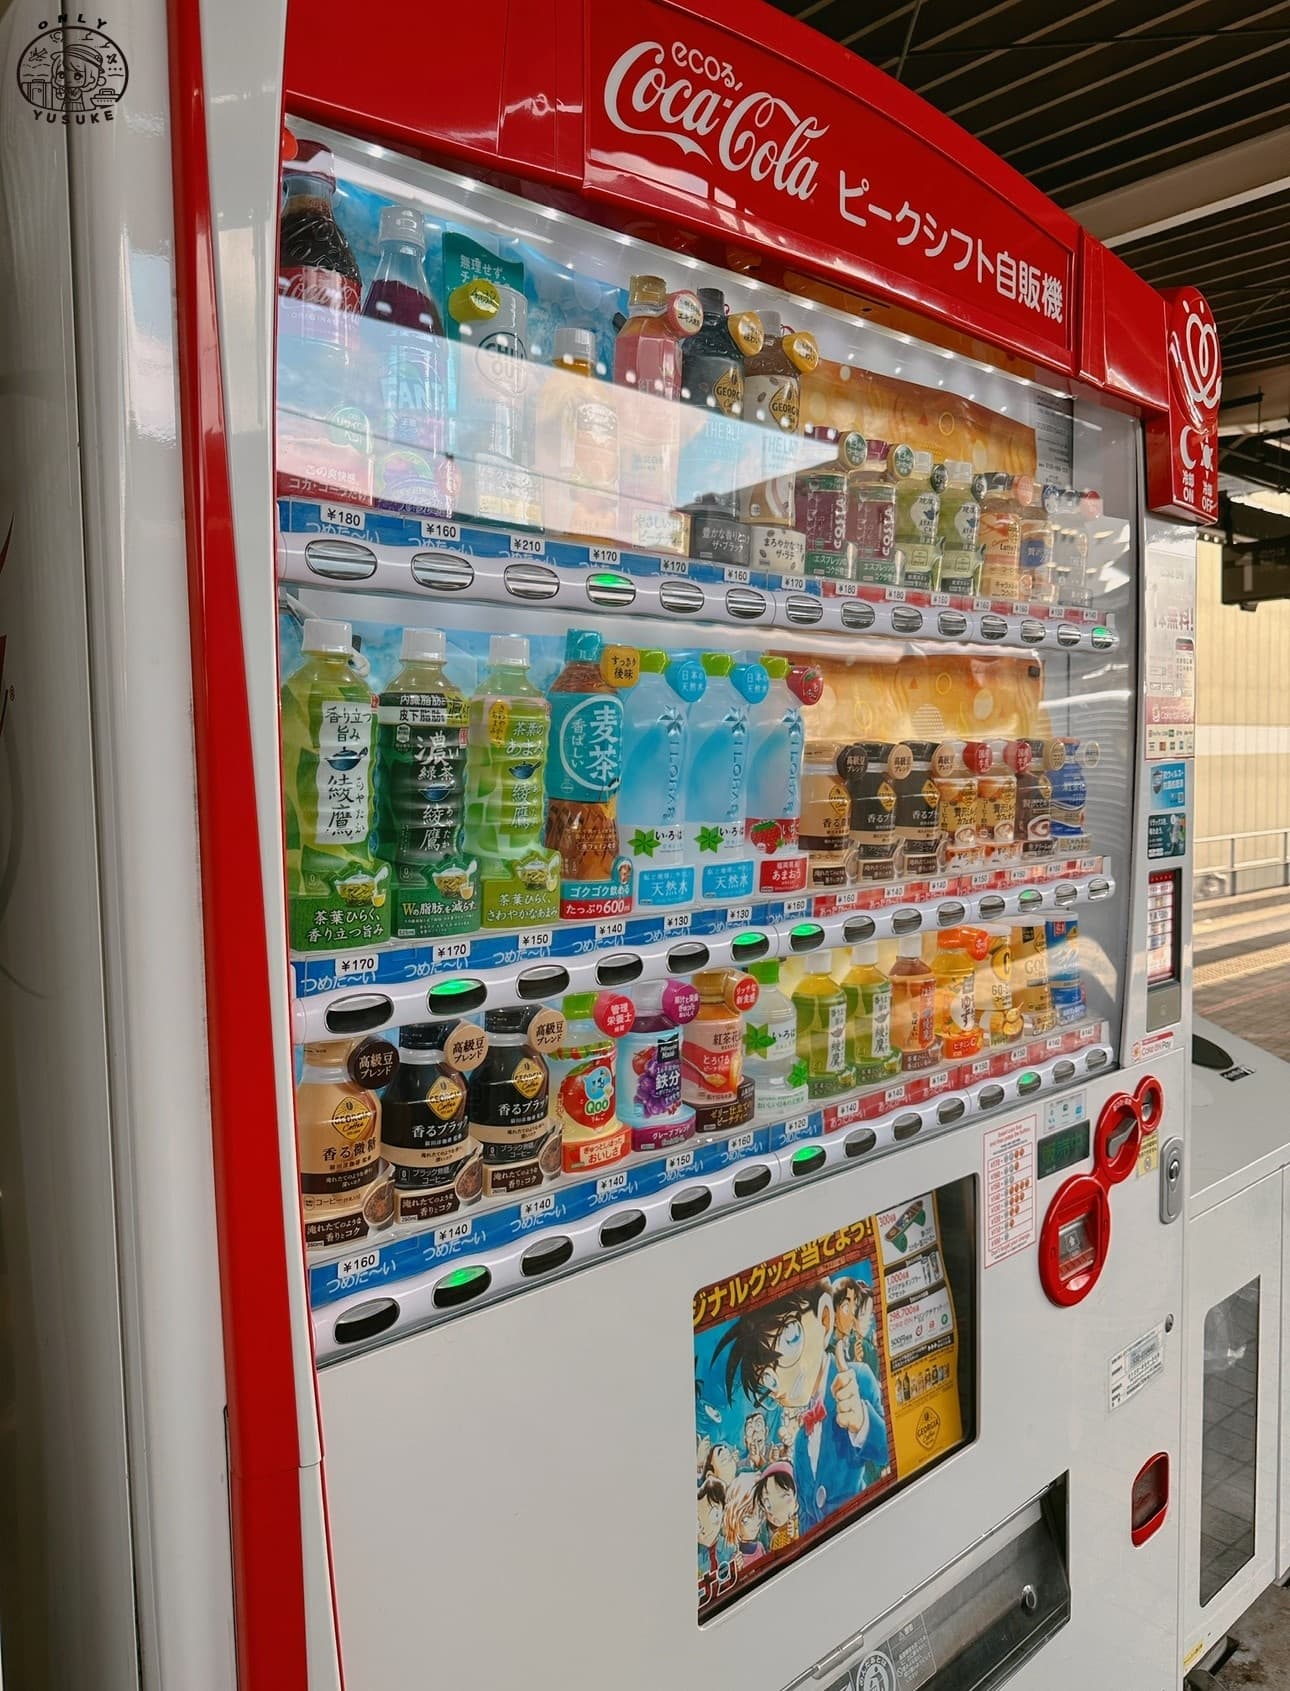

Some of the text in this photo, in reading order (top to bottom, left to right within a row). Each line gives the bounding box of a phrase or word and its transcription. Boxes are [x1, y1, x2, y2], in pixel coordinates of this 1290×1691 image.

[604, 41, 831, 200] Coca-Cola
[839, 169, 1063, 324] ピークシフト自販機
[327, 507, 361, 527] ¥180
[426, 523, 457, 538] ¥160
[514, 538, 541, 552] ¥210
[593, 549, 617, 562] ¥170
[663, 559, 686, 573] ¥170
[611, 656, 637, 668] すっきり
[614, 668, 634, 680] 後味
[325, 706, 372, 724] 香り立つ
[337, 724, 361, 743] 旨み
[513, 722, 544, 737] 茶葉の
[414, 730, 460, 767] 濃い
[506, 740, 544, 757] あまみ
[571, 718, 586, 768] 香ばしい
[586, 705, 619, 782] 麦茶
[417, 766, 455, 780] 緑茶
[511, 783, 531, 830] 綾鷹
[420, 804, 445, 852] 綾鷹
[715, 873, 750, 889] 天然水
[771, 869, 801, 880] あまおう
[570, 884, 630, 898] ゴクゴク飲める
[651, 880, 688, 897] 天然水
[499, 893, 552, 907] 茶葉ひらく、
[314, 907, 381, 926] 茶葉ひらく、
[487, 907, 558, 922] さわやかなあまみ
[666, 916, 689, 927] ¥130
[729, 909, 750, 920] ¥130
[308, 925, 384, 943] 香り立つ旨み
[600, 924, 623, 934] ¥140
[523, 934, 548, 945] ¥150
[437, 944, 467, 957] ¥170
[341, 958, 375, 972] ¥170
[610, 1002, 629, 1014] 管理
[535, 1022, 563, 1037] 高級豆
[452, 1036, 486, 1055] 高級豆
[537, 1035, 562, 1046] ブレンド
[359, 1051, 394, 1069] 高級豆
[454, 1050, 484, 1064] ブレンド
[703, 1055, 730, 1066] とろける
[361, 1066, 392, 1080] ブレンド
[655, 1071, 681, 1091] 鉄分
[887, 1088, 903, 1099] ¥140
[585, 1099, 609, 1116] Qoo
[840, 1102, 857, 1113] ¥140
[731, 1136, 751, 1148] ¥160
[588, 1148, 619, 1163] おいしさ
[669, 1154, 690, 1167] ¥150
[601, 1177, 624, 1189] ¥140
[420, 1202, 453, 1217] 香りとコク
[525, 1198, 551, 1214] ¥140
[326, 1227, 361, 1243] 香りとコク
[439, 1223, 468, 1241] ¥140
[343, 1253, 375, 1273] ¥160
[917, 1420, 940, 1436] GEORGIA
